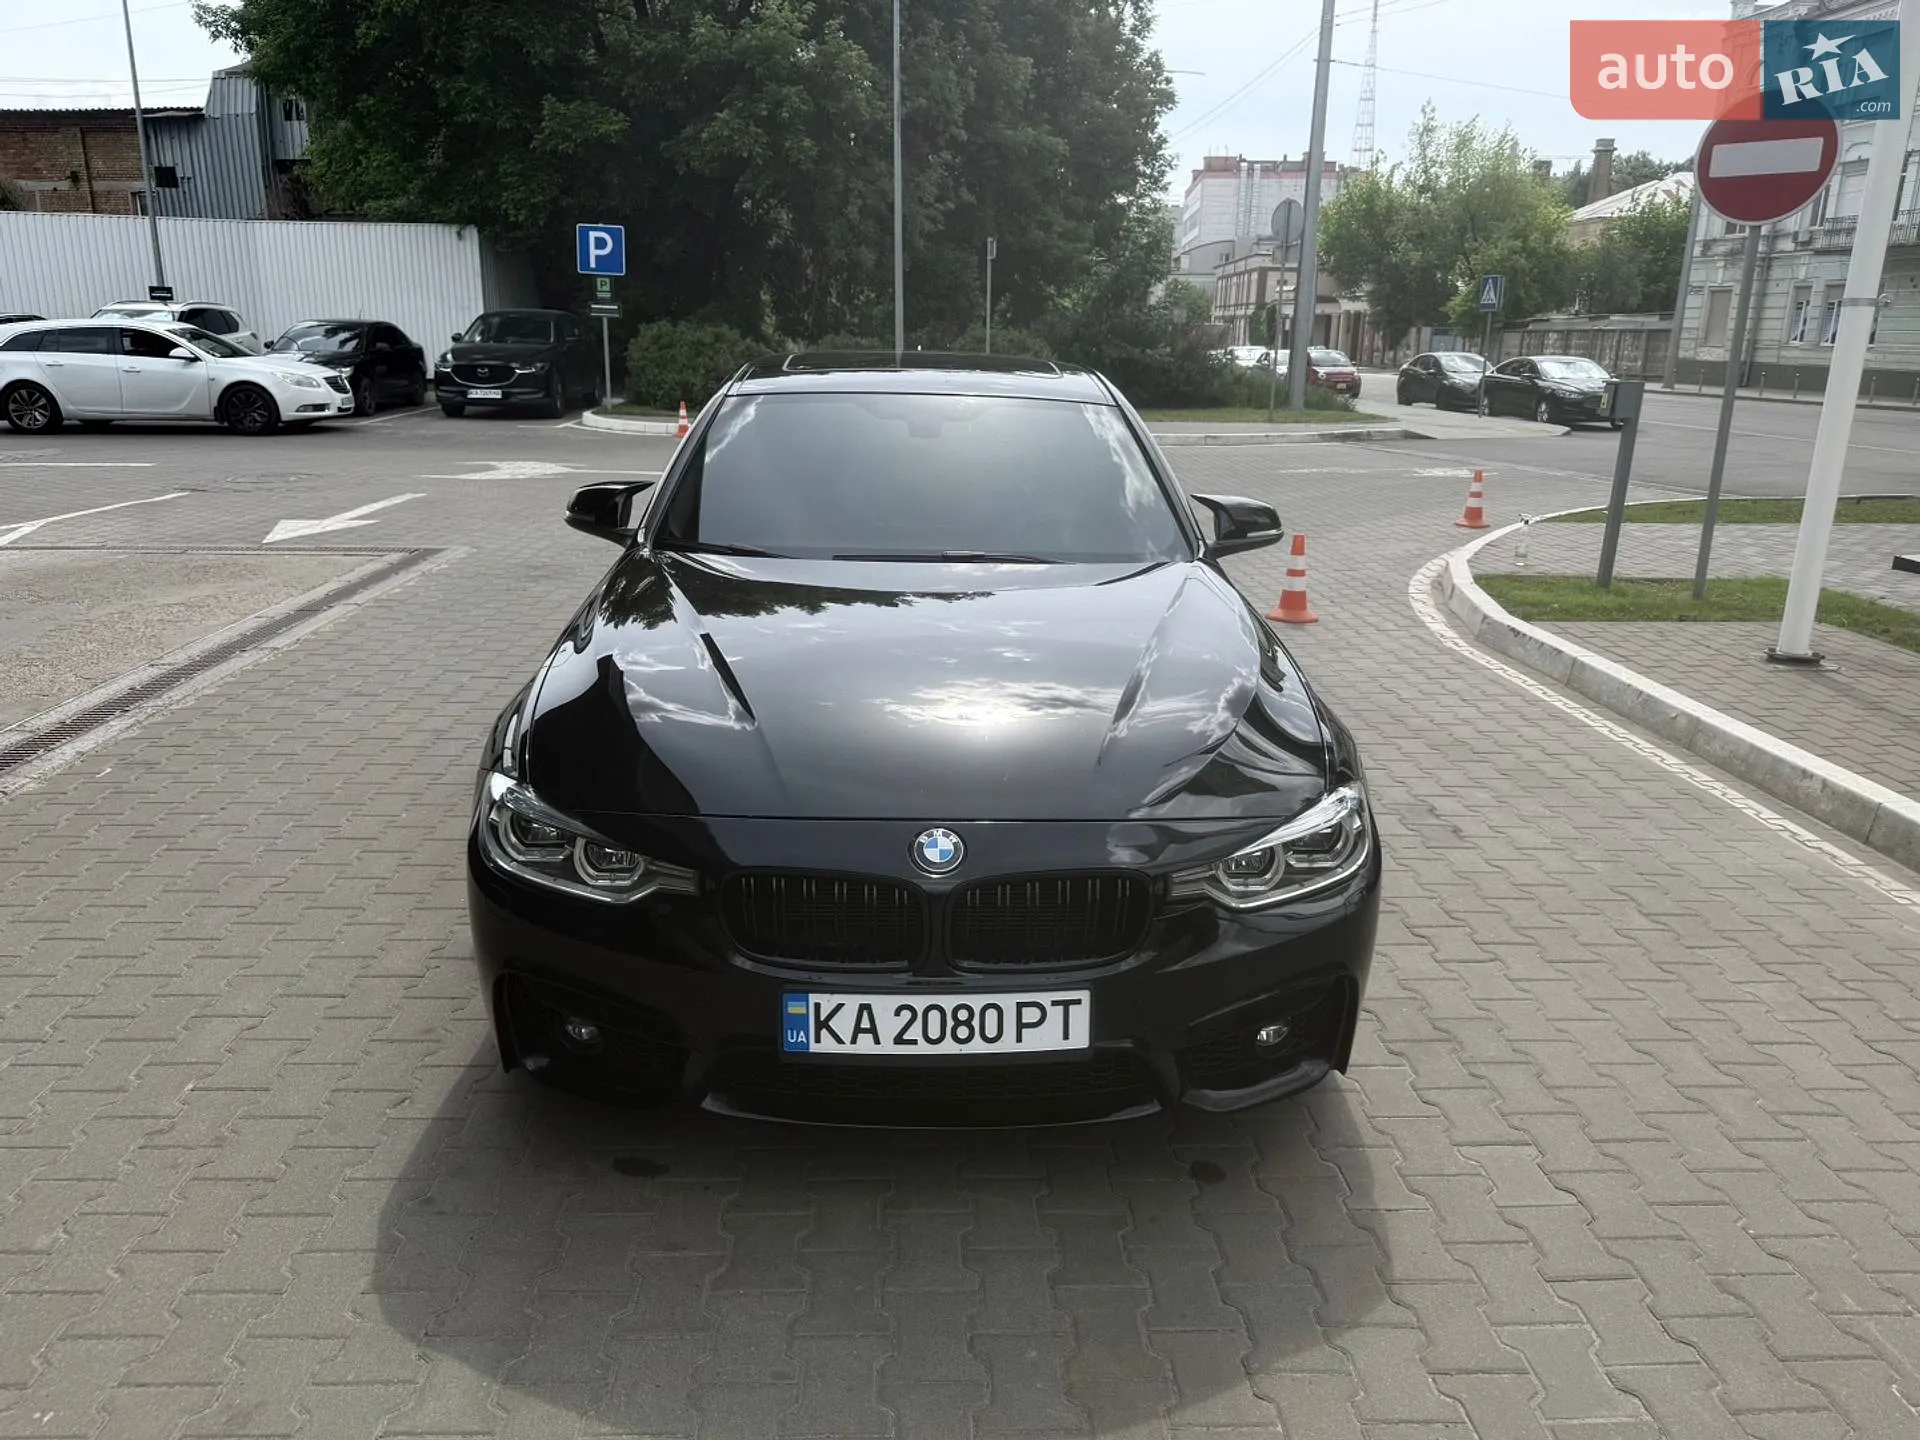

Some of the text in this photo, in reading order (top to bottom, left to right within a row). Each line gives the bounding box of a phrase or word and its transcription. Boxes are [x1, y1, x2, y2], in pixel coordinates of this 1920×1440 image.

[589, 231, 613, 268] P
[918, 829, 960, 844] BMW
[813, 998, 1083, 1046] KA 2080 PT
[787, 1029, 807, 1044] UA
